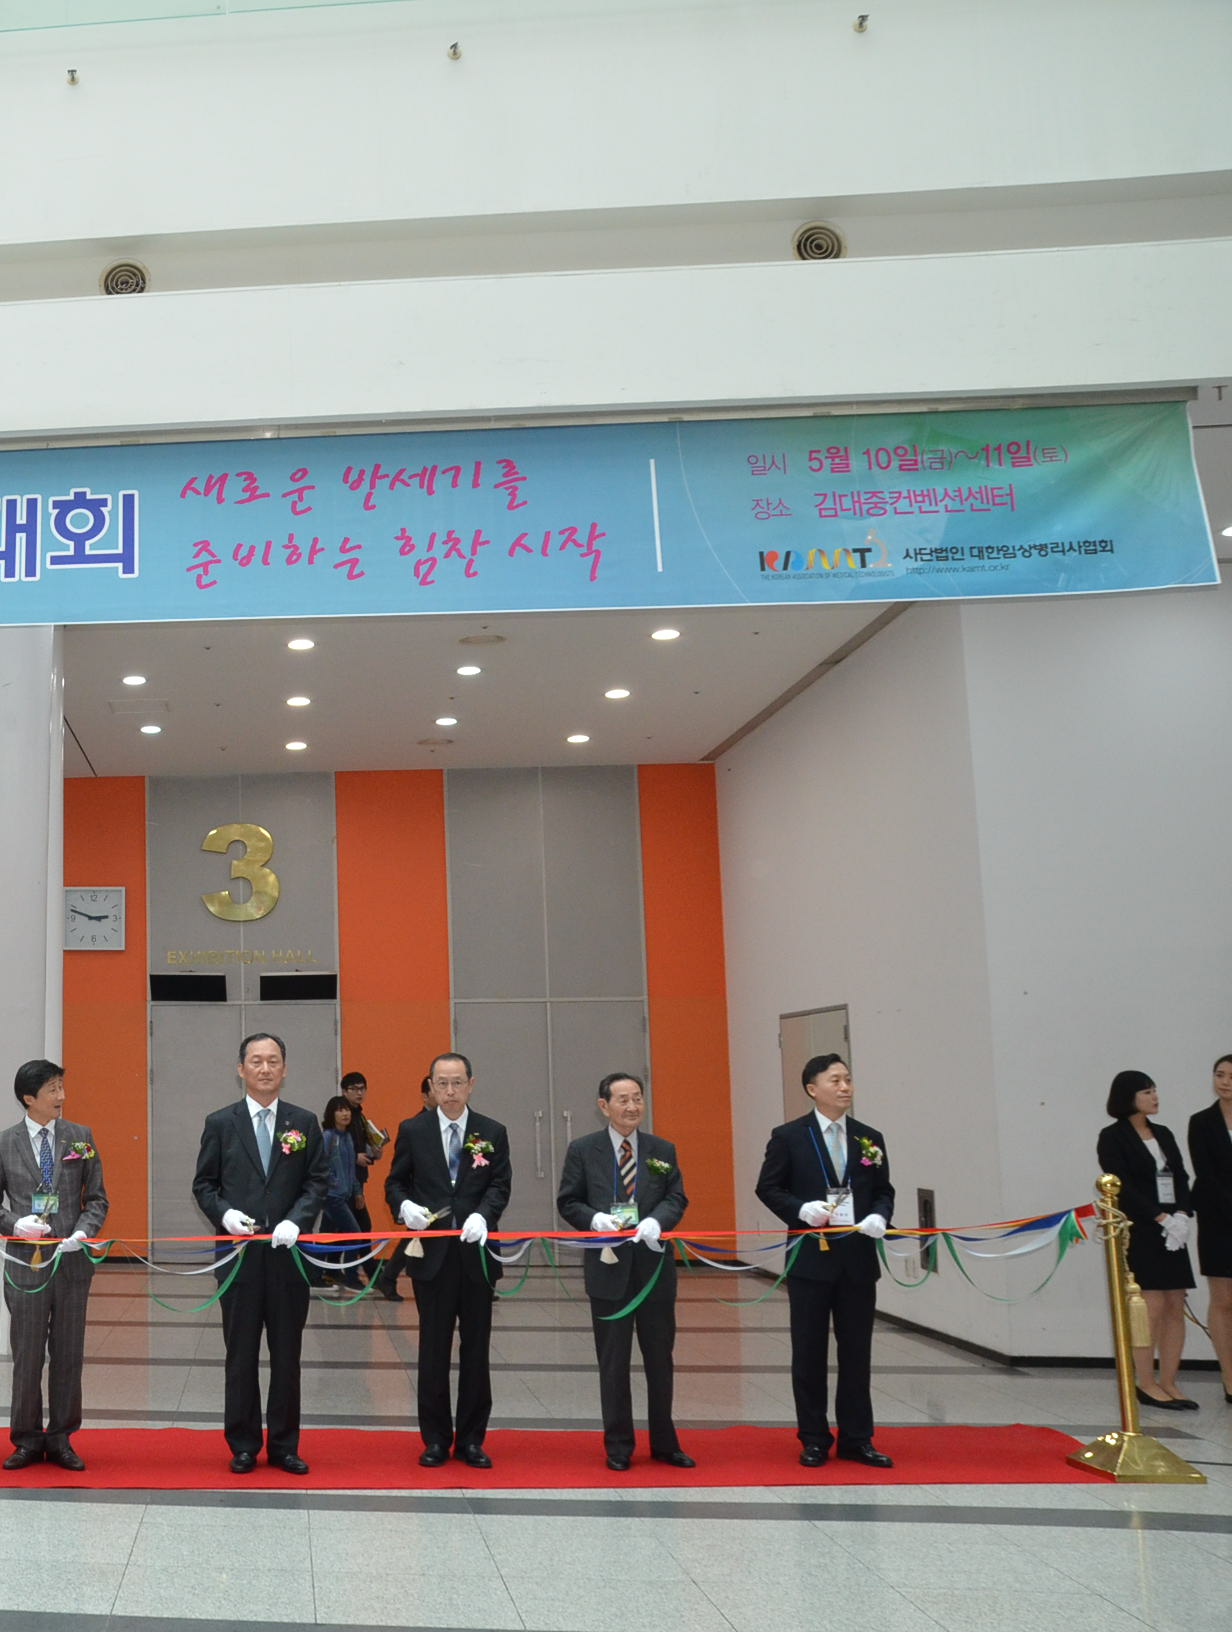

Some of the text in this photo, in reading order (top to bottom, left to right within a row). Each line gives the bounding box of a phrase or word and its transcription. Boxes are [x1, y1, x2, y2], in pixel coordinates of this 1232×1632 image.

[747, 452, 787, 475] 일시
[808, 446, 851, 473] 5월
[180, 458, 528, 515] 새로운 반세기를
[752, 484, 1017, 520] 장소 김대중컨벤션센터
[186, 522, 606, 589] 준비하는 힘찬 시작
[903, 539, 1115, 562] 사단법인 대한임상병리사협회
[201, 823, 280, 921] 3
